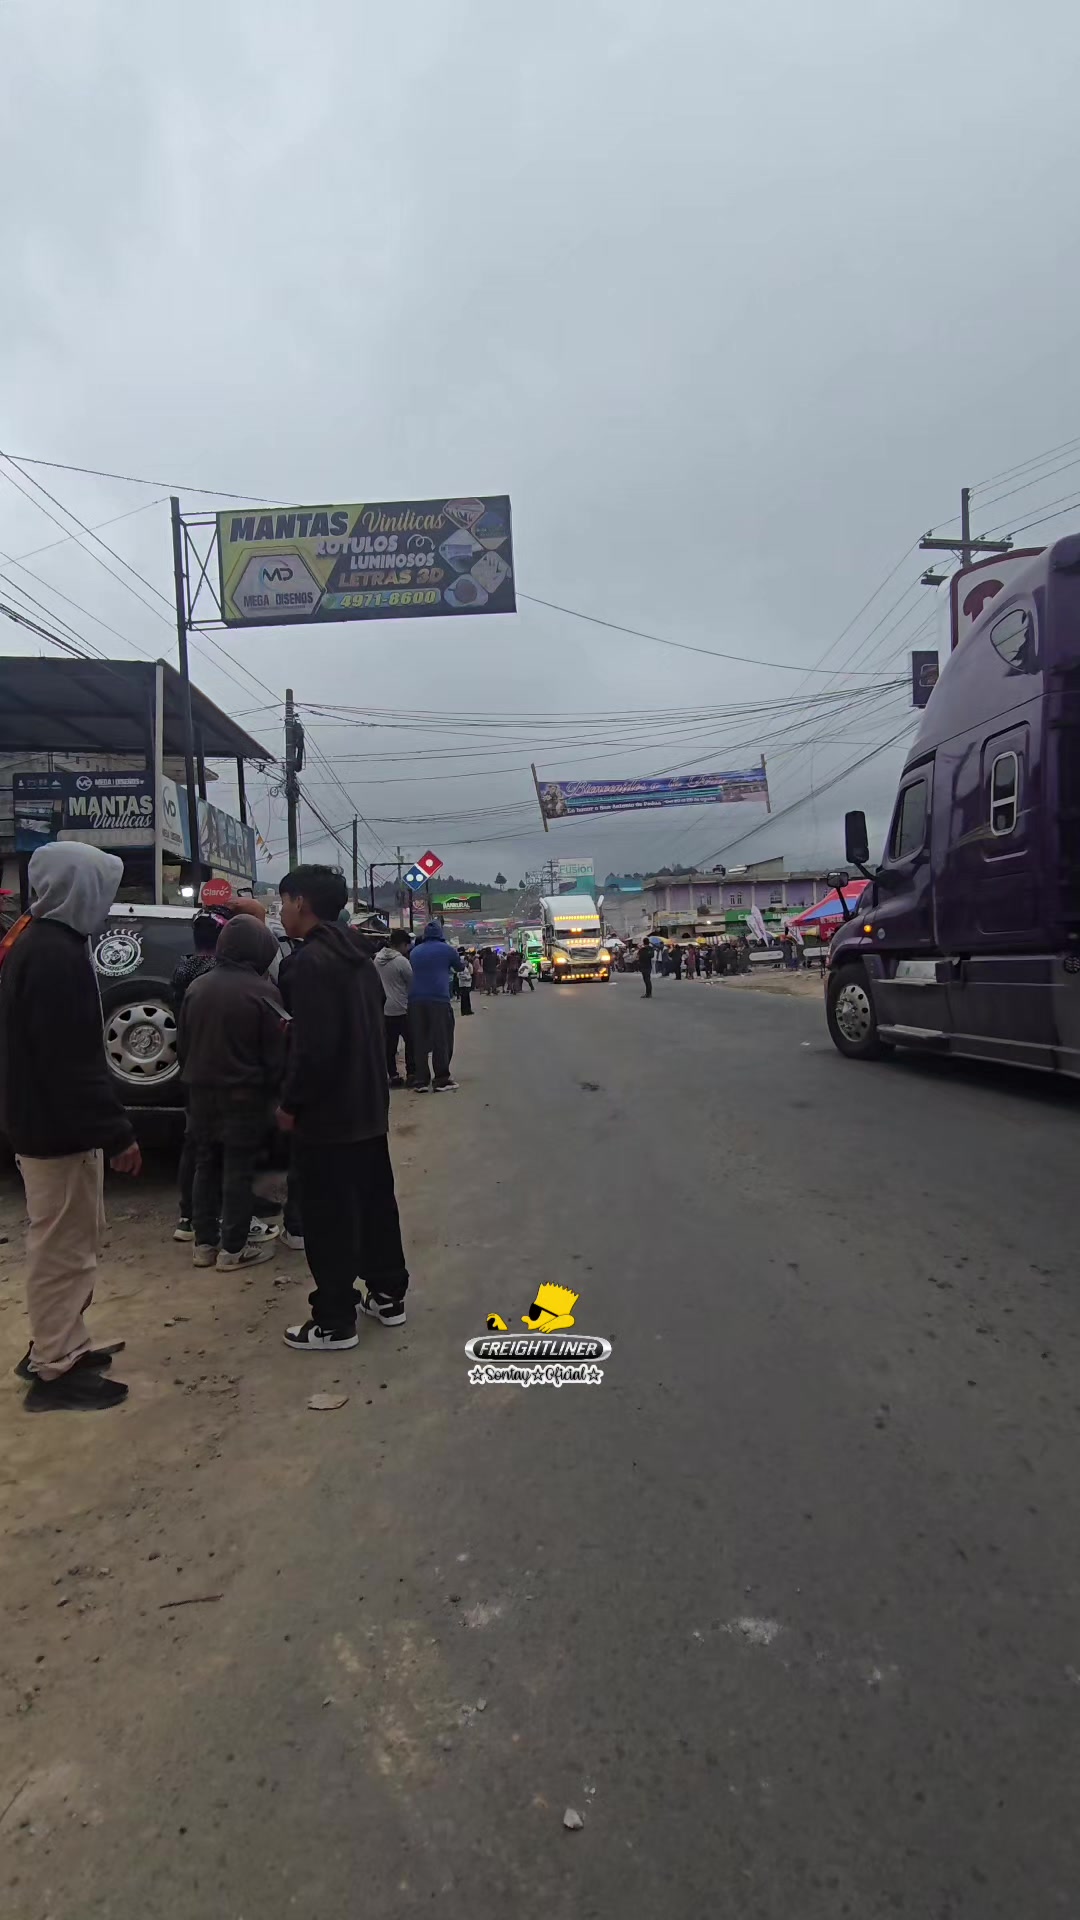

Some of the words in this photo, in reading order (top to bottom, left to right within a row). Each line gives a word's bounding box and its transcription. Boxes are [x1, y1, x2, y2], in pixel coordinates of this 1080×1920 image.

[230, 512, 349, 542] MANTAS
[350, 552, 434, 569] LUMINOSOS
[338, 569, 412, 587] LETRAS
[416, 567, 445, 584] 3D
[244, 595, 270, 607] MEGA
[341, 590, 437, 608] 4971-8600
[68, 795, 153, 816] MANTAS
[203, 887, 225, 897] Claro
